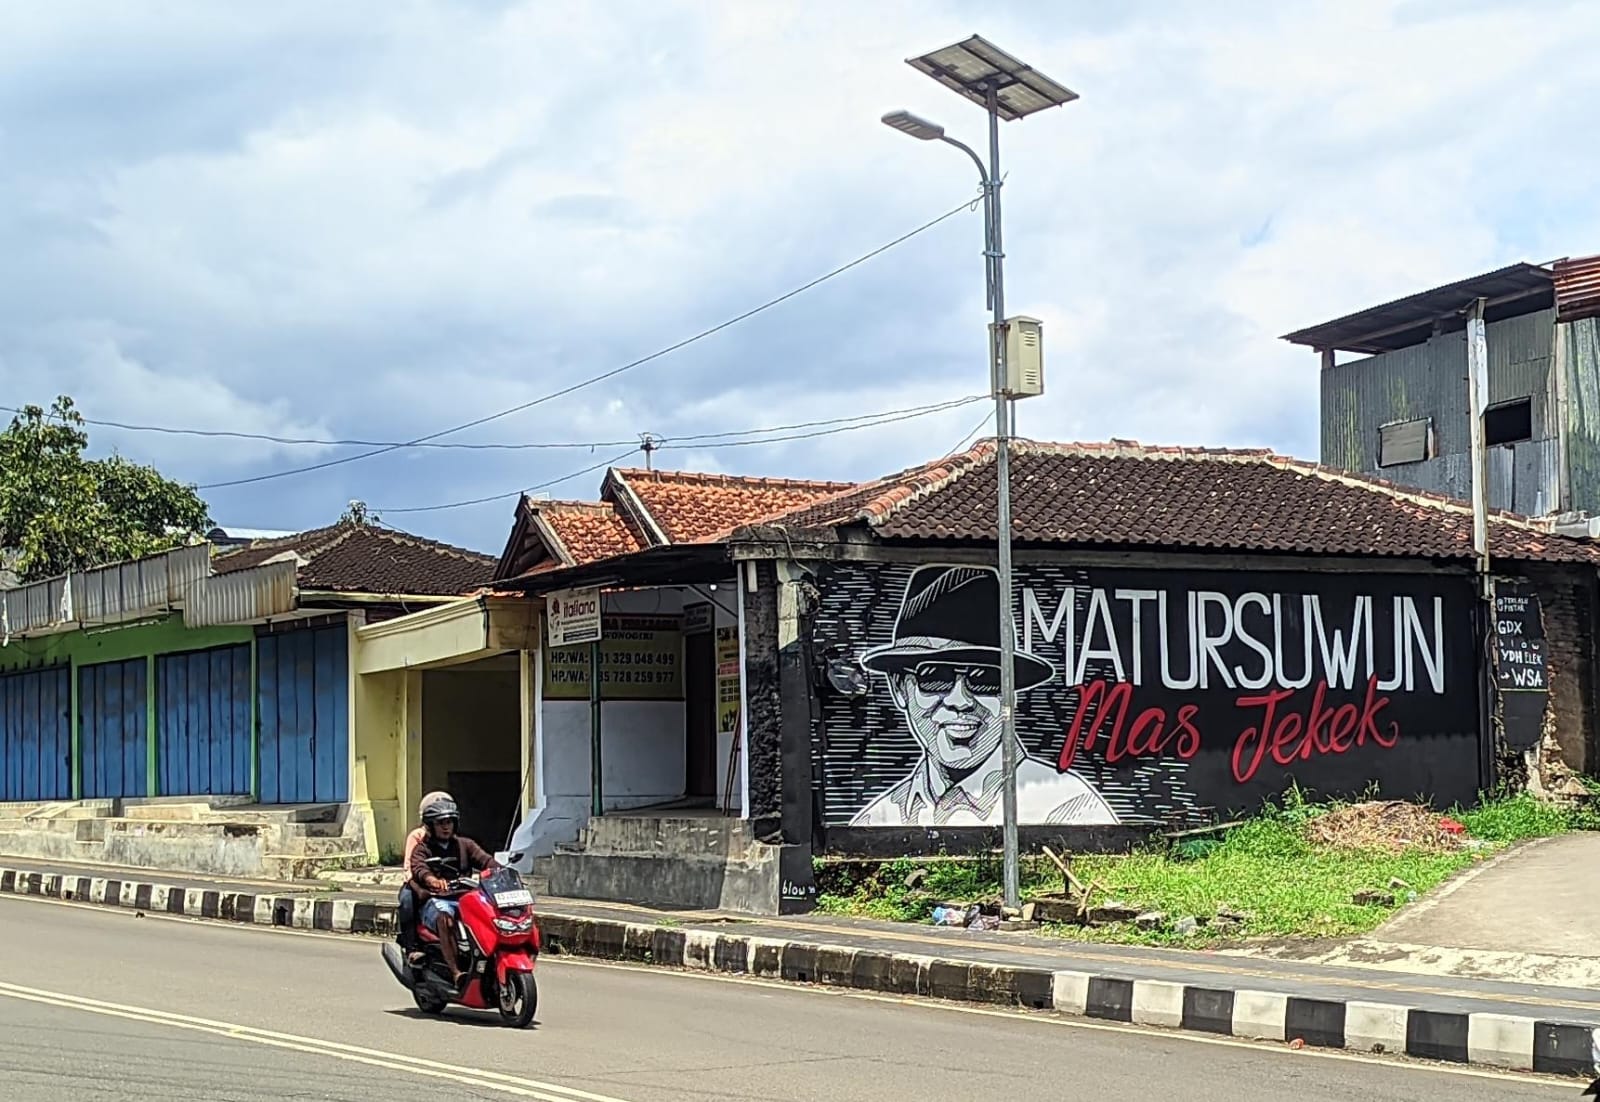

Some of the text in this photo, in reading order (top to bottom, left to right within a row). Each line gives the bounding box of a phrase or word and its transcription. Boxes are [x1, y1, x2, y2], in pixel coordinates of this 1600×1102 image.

[1497, 620, 1523, 635] GDX
[613, 652, 632, 665] 329
[656, 653, 675, 665] 499
[613, 671, 632, 683] 728
[634, 671, 654, 683] 259
[656, 671, 675, 683] 977
[1510, 667, 1543, 687] WSA
[1056, 673, 1398, 784] Mas Jekek
